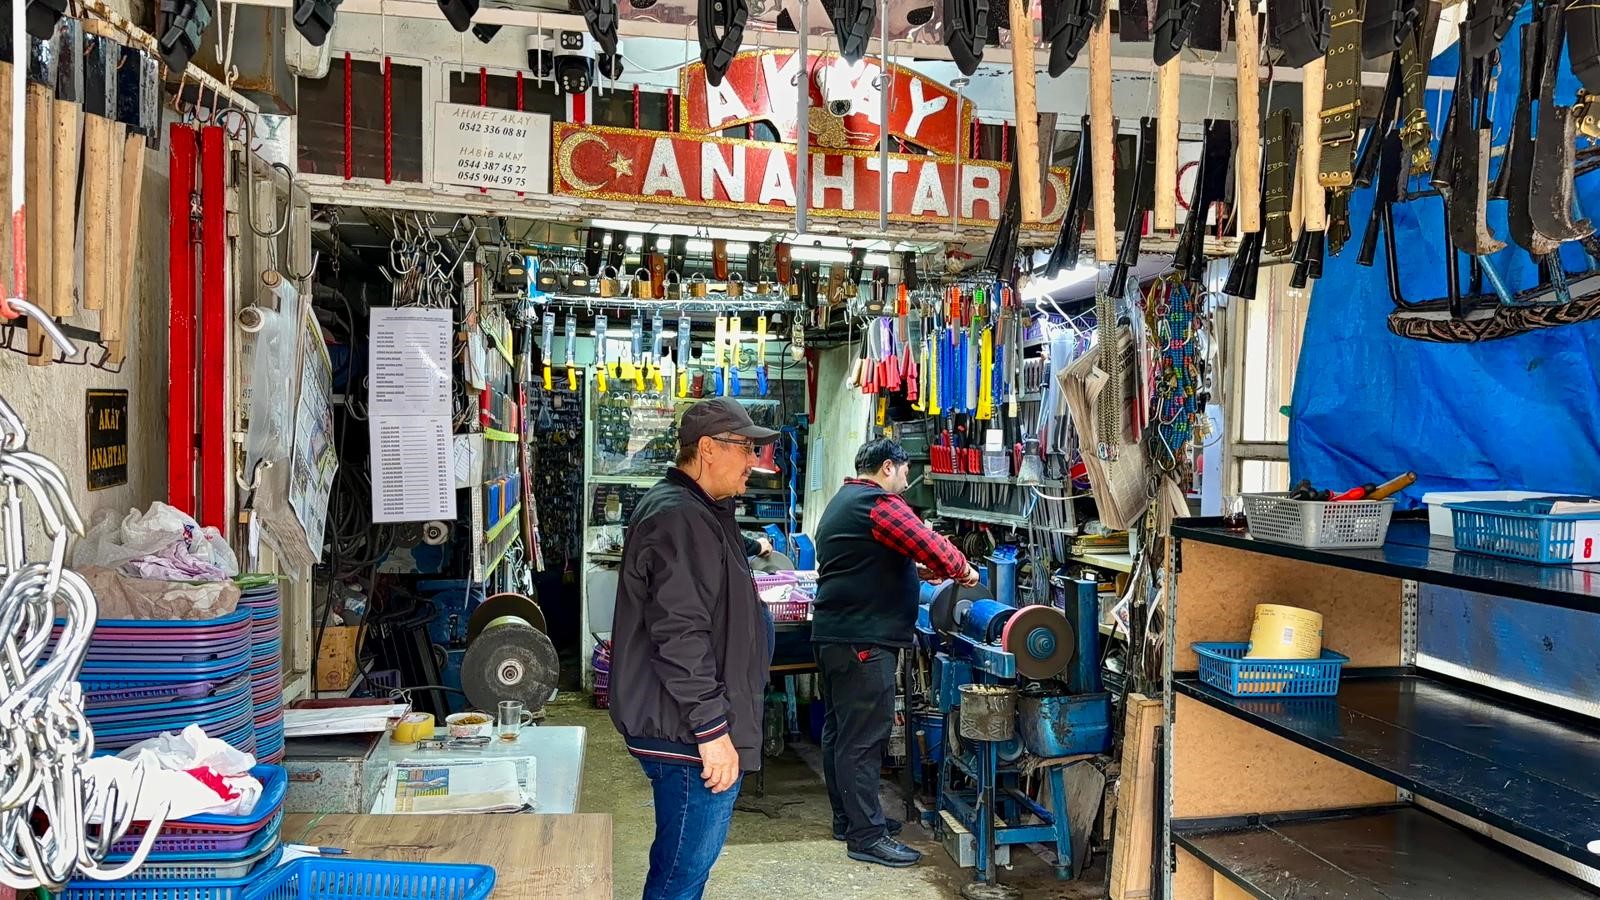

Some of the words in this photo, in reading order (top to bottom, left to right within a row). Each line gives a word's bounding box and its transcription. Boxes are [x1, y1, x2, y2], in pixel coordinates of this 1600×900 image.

[453, 108, 498, 121] AHMET
[501, 114, 532, 126] AKAY
[459, 122, 481, 132] 0542
[484, 125, 500, 135] 336
[502, 128, 514, 136] 08
[515, 129, 527, 138] 81
[498, 152, 523, 161] AKAY
[458, 160, 480, 169] 0544
[483, 162, 500, 171] 387
[502, 164, 513, 173] 45
[515, 166, 527, 174] 27
[457, 172, 480, 181] 0545
[483, 174, 499, 183] 904
[501, 176, 513, 185] 59
[515, 178, 526, 187] 75
[642, 138, 1001, 219] ANAHTAR
[99, 408, 120, 430] AKAY
[91, 445, 127, 470] ANAHTAR
[1584, 538, 1593, 558] 8
